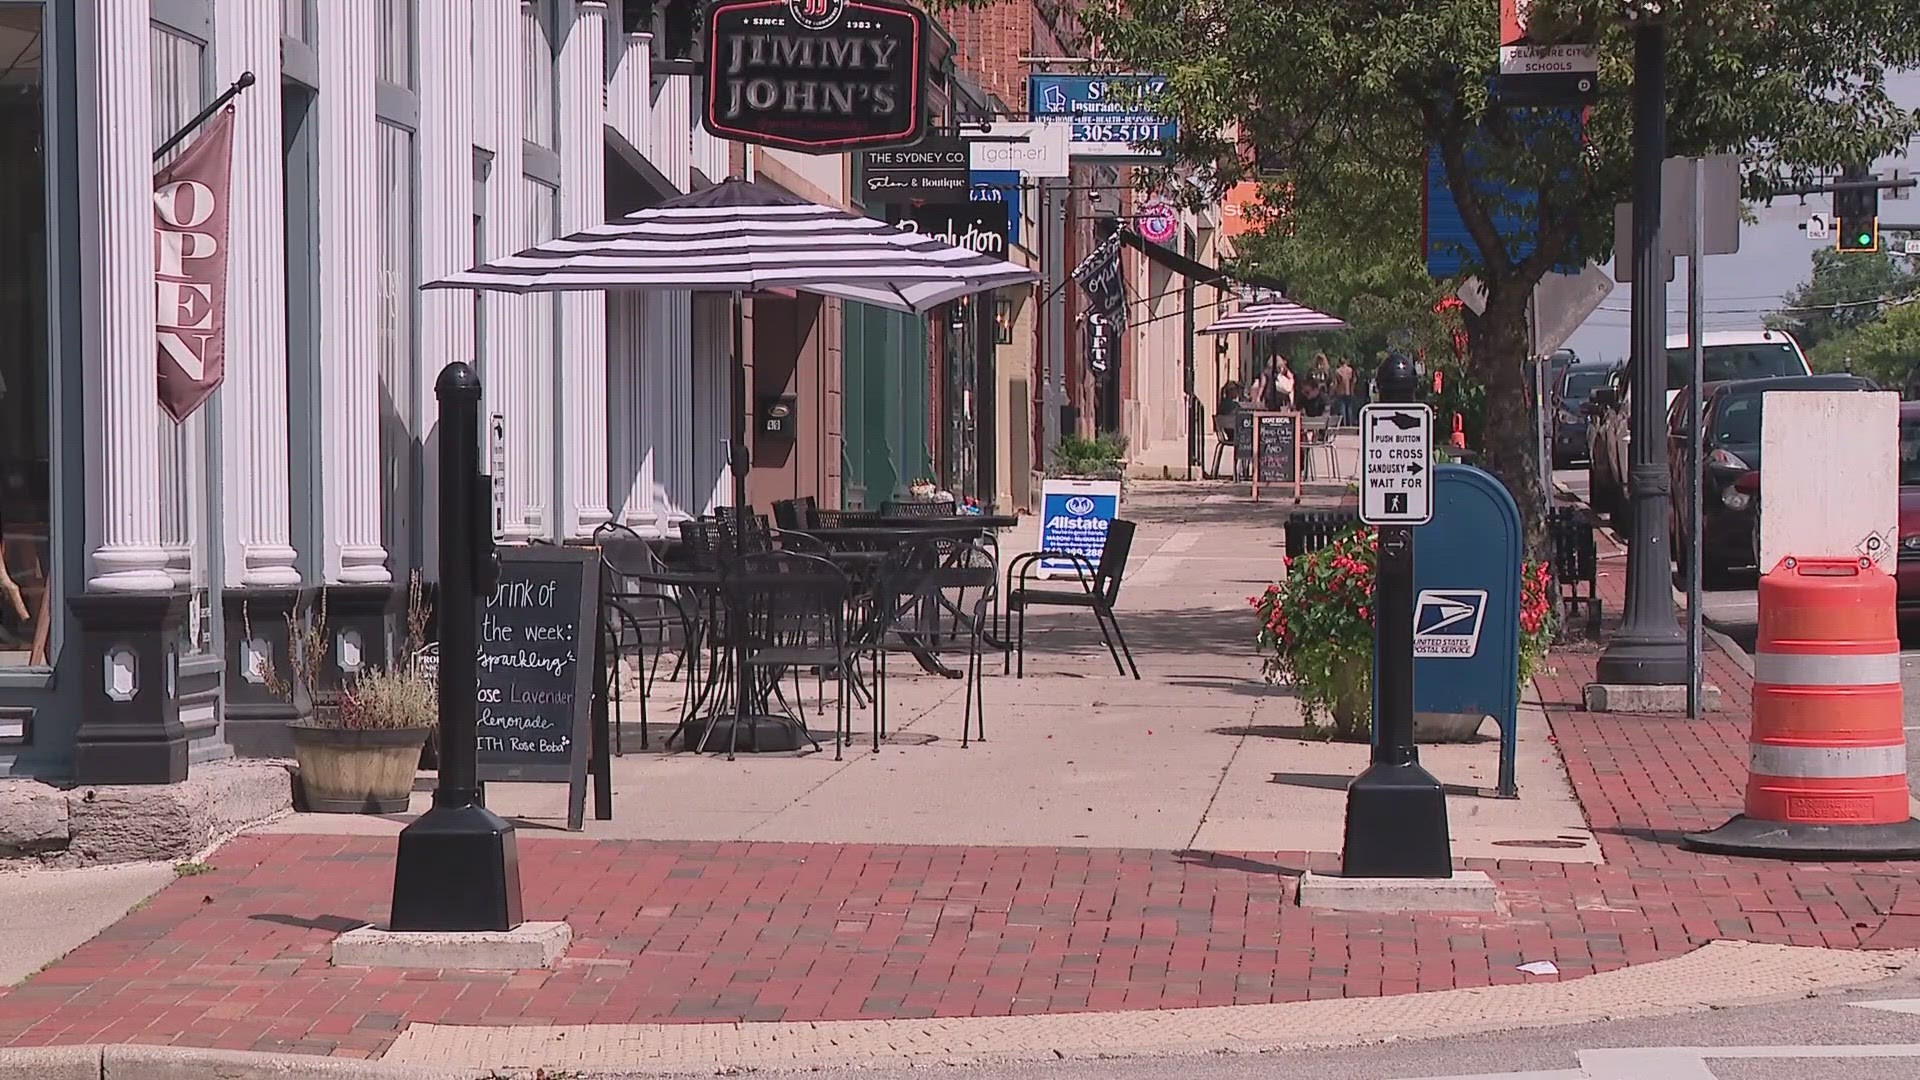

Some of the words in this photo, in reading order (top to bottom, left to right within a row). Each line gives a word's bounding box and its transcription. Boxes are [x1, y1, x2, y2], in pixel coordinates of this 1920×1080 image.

[752, 17, 785, 26] SINCE
[847, 21, 871, 29] 1983
[728, 34, 898, 73] JIMMY
[1510, 48, 1564, 58] DELARE
[1525, 62, 1573, 72] SCHOOLS
[726, 78, 896, 118] JOHN'S
[869, 152, 892, 163] THE
[895, 152, 942, 164] SYDNEY
[945, 152, 966, 164] CO.
[867, 176, 909, 190] Salon
[911, 177, 918, 187] &
[921, 176, 966, 190] Boutique
[896, 217, 1002, 253] Rolution
[153, 180, 217, 381] OPEN
[1089, 313, 1108, 372] GIFTS
[1375, 435, 1394, 443] PUSH
[1395, 435, 1421, 443] BUTTON
[1369, 449, 1382, 459] TO
[1389, 449, 1423, 459] CROSS
[1368, 463, 1405, 474] SANDUSKY
[1370, 478, 1394, 488] WAIT
[1401, 478, 1422, 488] FOR
[1046, 515, 1108, 530] Allstate
[538, 579, 557, 608] of
[482, 613, 513, 642] the
[1415, 646, 1439, 654] OSTAL
[1440, 646, 1471, 654] SERVICE
[477, 682, 502, 703] ose
[511, 682, 574, 705] Lavender
[477, 707, 555, 731] lemonade
[477, 736, 504, 752] ITH
[509, 736, 537, 752] Rose
[539, 737, 565, 753] Boba
